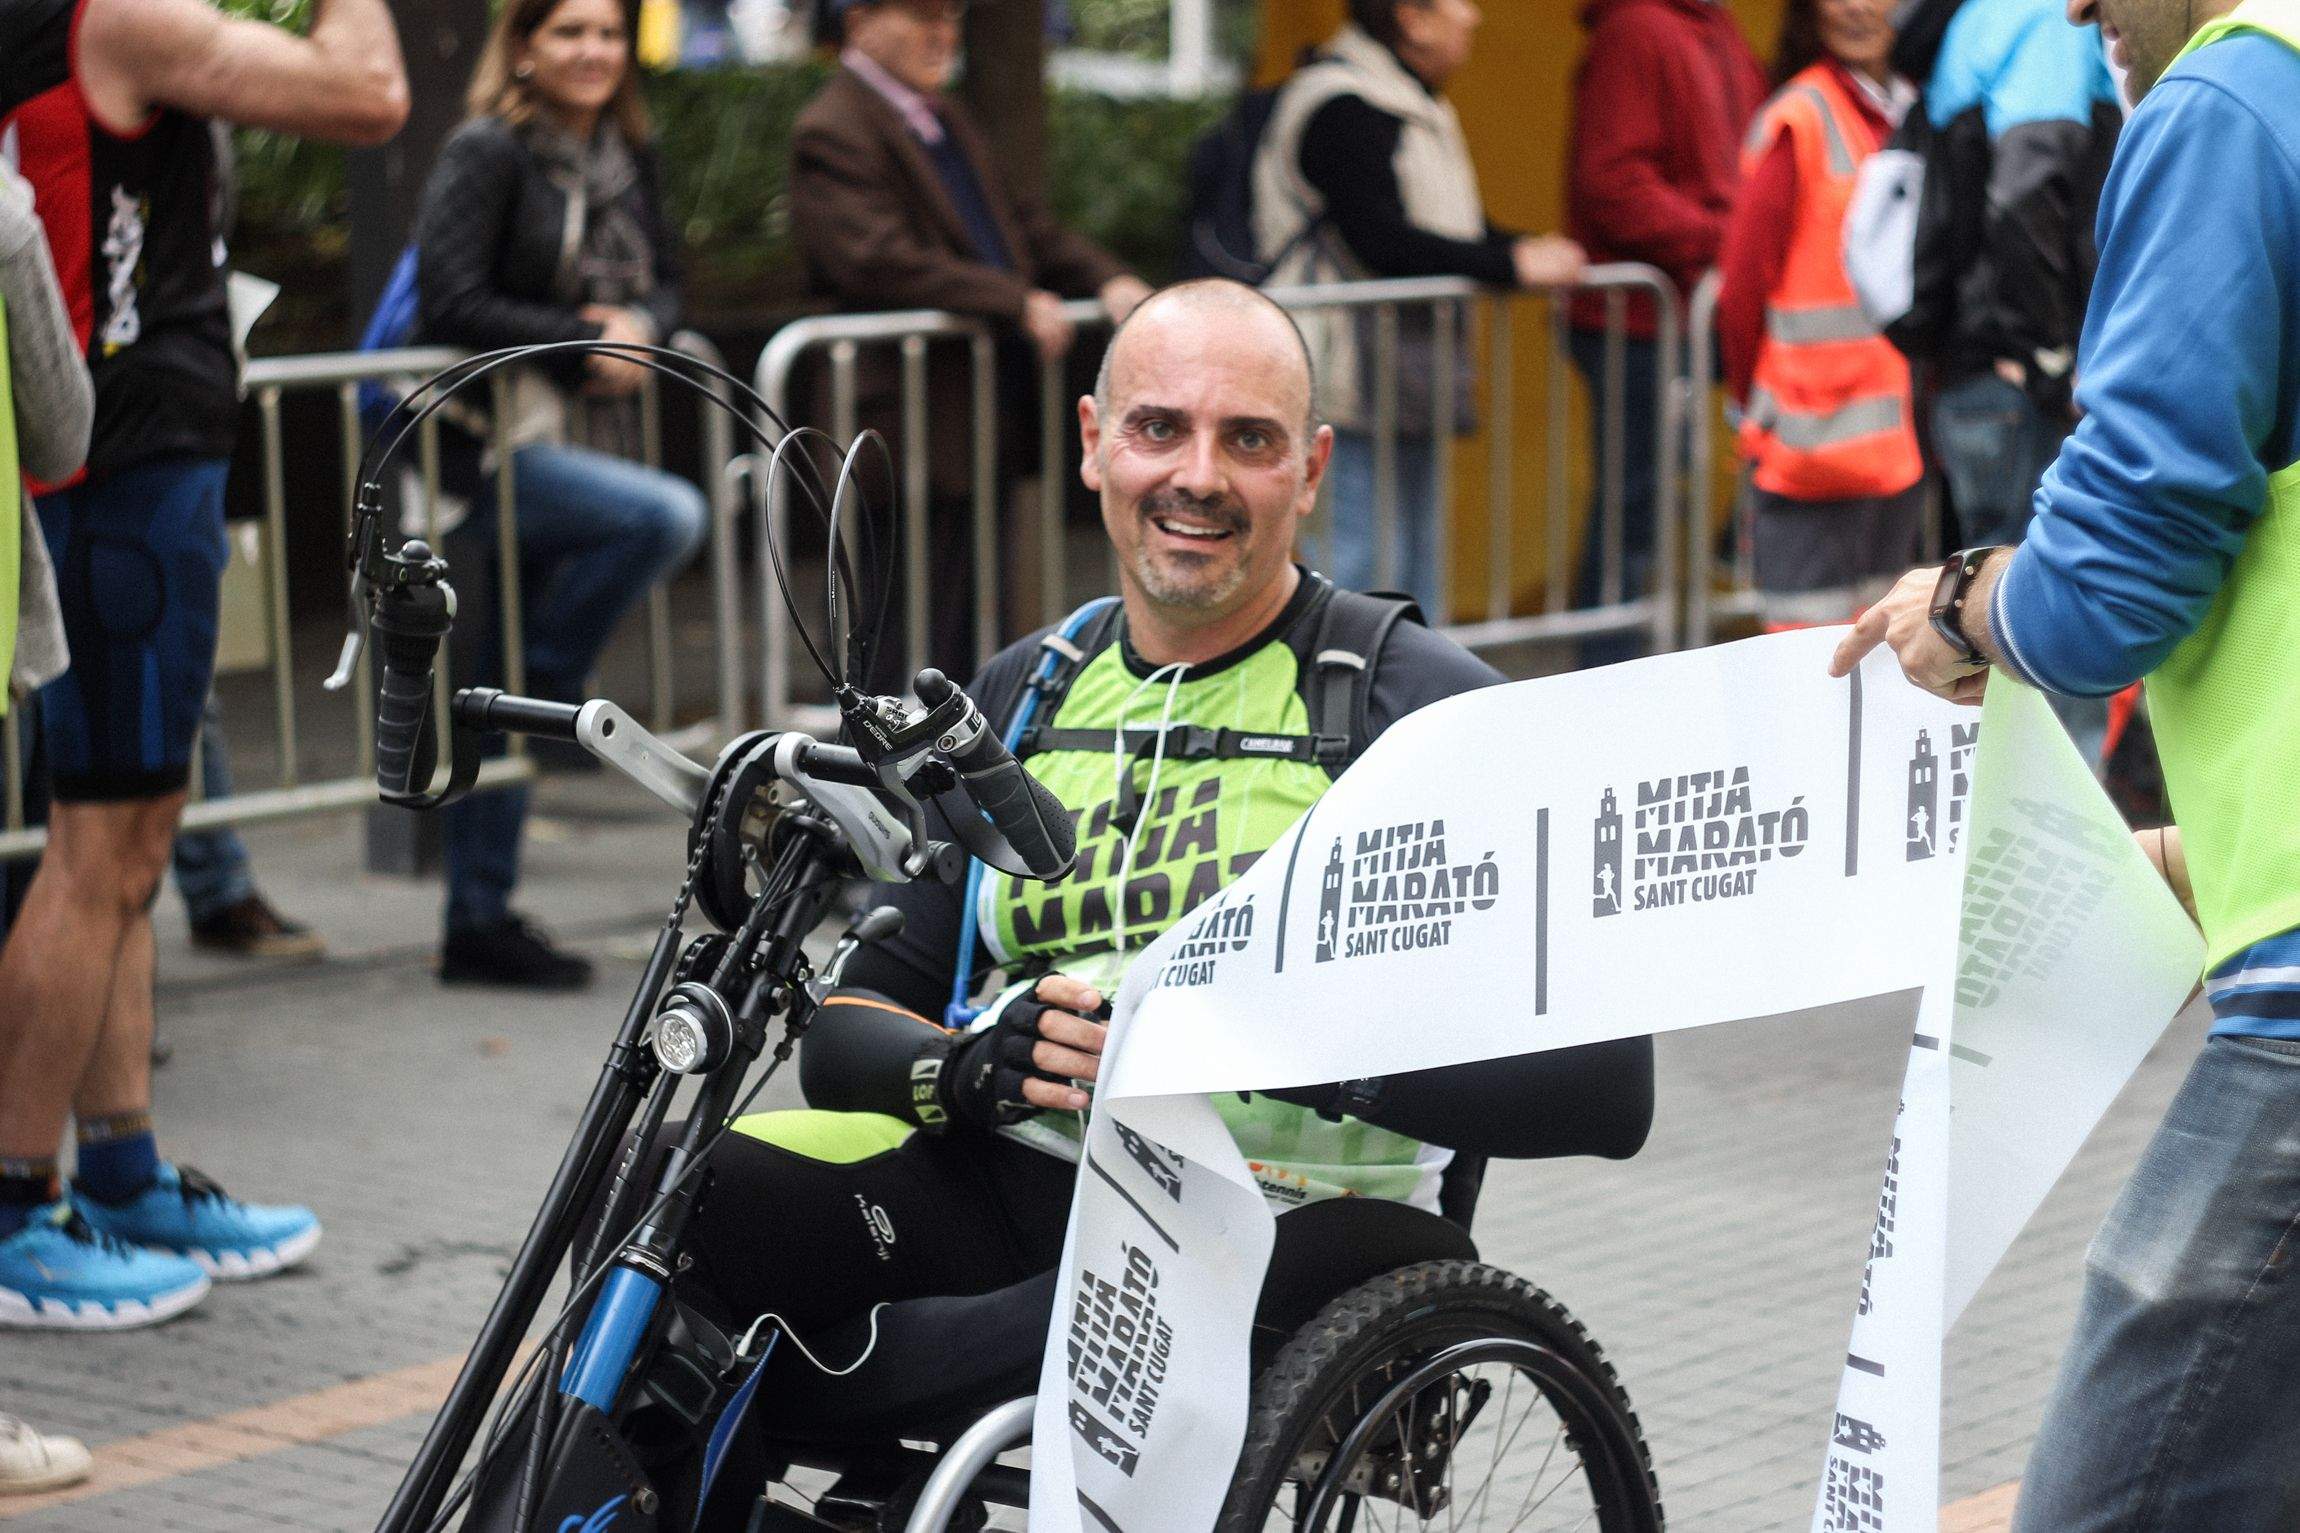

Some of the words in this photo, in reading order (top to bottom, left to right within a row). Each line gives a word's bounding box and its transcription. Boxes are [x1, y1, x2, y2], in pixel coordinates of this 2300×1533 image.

[862, 720, 893, 752] DEORE
[1635, 766, 1752, 829] MITJA
[1352, 819, 1446, 878] MITJA
[1634, 796, 1809, 881] MARATÓ
[1347, 851, 1499, 928] MARATÓ
[1634, 879, 1688, 911] SANT
[1692, 869, 1757, 902] CUGAT
[1345, 928, 1388, 958] SANT
[1391, 920, 1452, 952] CUGAT
[1164, 960, 1216, 987] CUGAT
[1067, 1269, 1118, 1395] MITJA
[1091, 1240, 1159, 1423] MARATÓ
[1128, 1379, 1159, 1439] SANT
[1146, 1315, 1173, 1384] CUGAT
